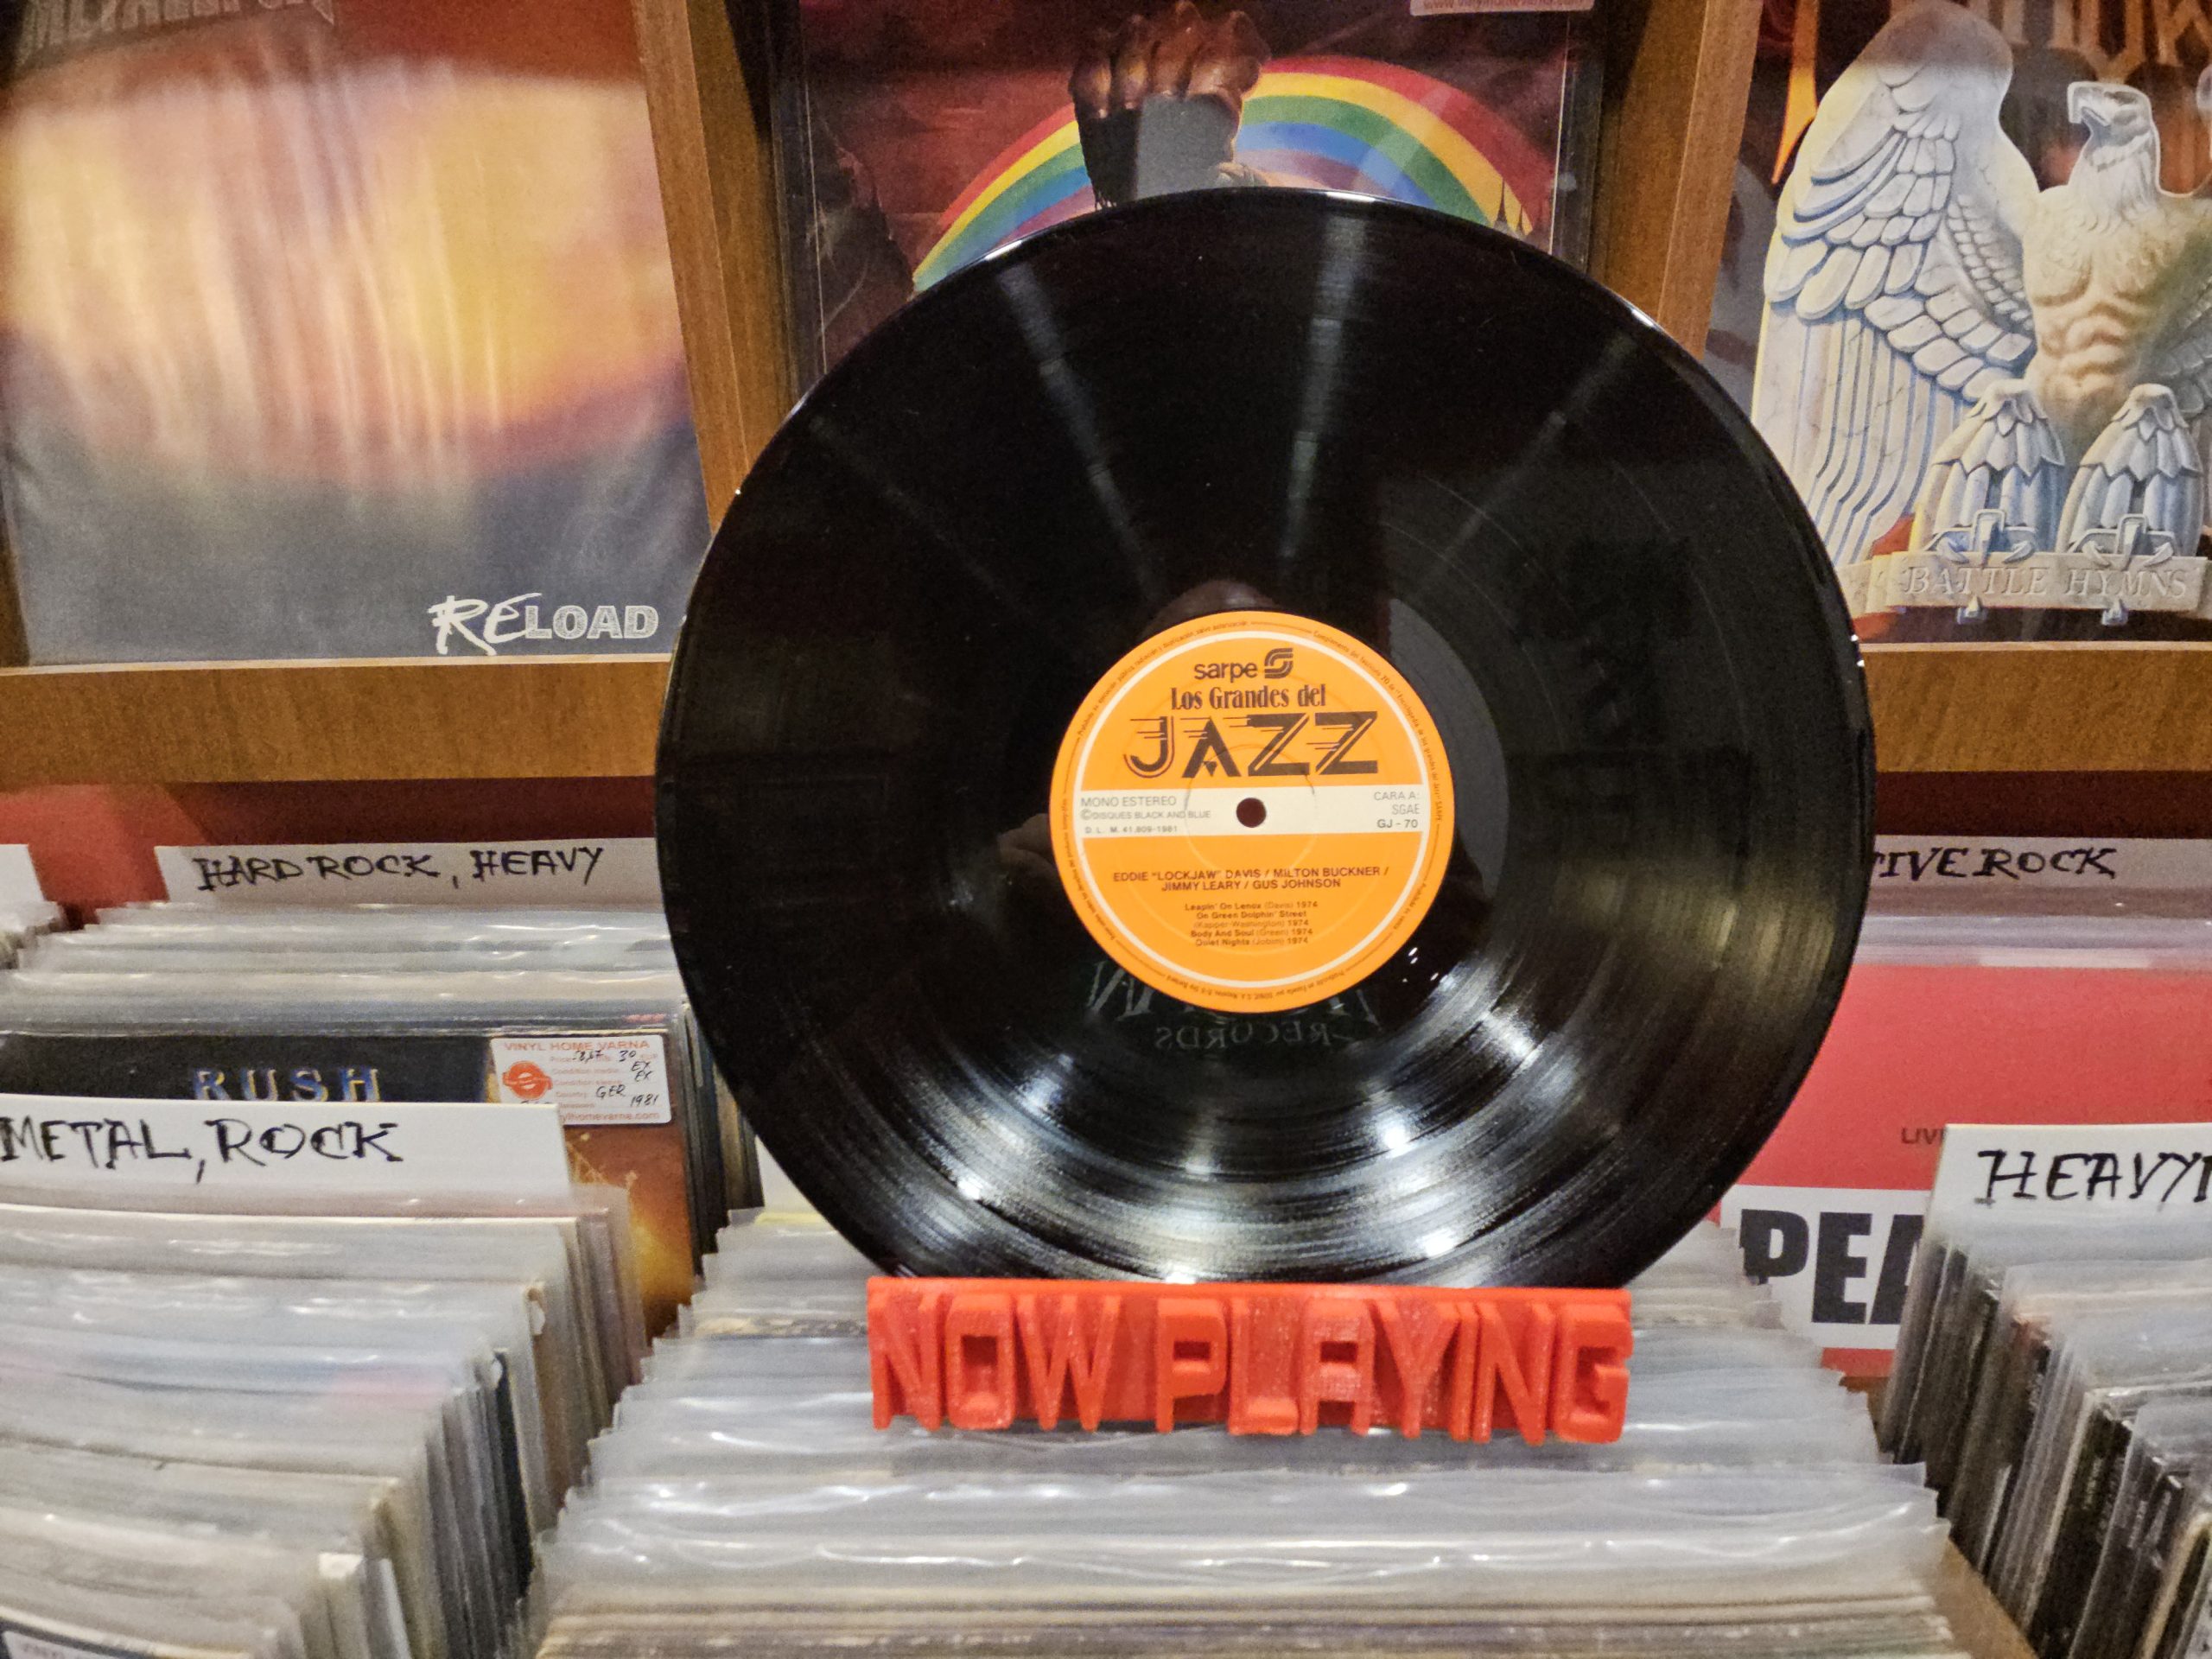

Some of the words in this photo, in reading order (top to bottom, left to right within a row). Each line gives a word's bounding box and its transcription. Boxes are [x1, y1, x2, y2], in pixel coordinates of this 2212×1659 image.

[1903, 565, 2050, 596] BATTLE
[2063, 567, 2189, 600] HYMNS
[1194, 661, 1258, 683] sarpe
[1172, 688, 1202, 710] Los
[1210, 685, 1289, 709] Grandes
[1298, 683, 1326, 707] del
[1123, 712, 1378, 779] JAZZ
[1081, 797, 1119, 807] MONO
[1122, 796, 1177, 806] ESTEREO
[1374, 791, 1405, 800] CARA
[1392, 804, 1420, 815] SGAE
[1377, 819, 1392, 828] GJ
[1404, 819, 1418, 828] 70
[192, 855, 303, 891] HARD
[470, 847, 604, 885] HEAVY
[1113, 872, 1148, 881] EDDIE
[1226, 869, 1261, 879] DAVIS
[1274, 868, 1319, 878] MILTON
[1323, 867, 1380, 877] BUCKNER
[1973, 846, 2117, 880] ROCK
[1161, 881, 1199, 892] JIMMY
[1203, 880, 1241, 890] LEARY
[1252, 880, 1278, 889] GUS
[1281, 878, 1341, 888] JOHNSON
[505, 1041, 546, 1052] VINYL
[550, 1041, 593, 1051] HOME
[597, 1040, 650, 1051] VARNA
[193, 1066, 381, 1102] RUSH
[629, 1094, 659, 1107] 1981
[204, 1118, 403, 1166] ROCK
[1902, 1128, 1946, 1144] LIV
[1974, 1149, 2202, 1207] HEAVY
[869, 1289, 1121, 1432] NOW
[1155, 1293, 1633, 1446] PLAYING
